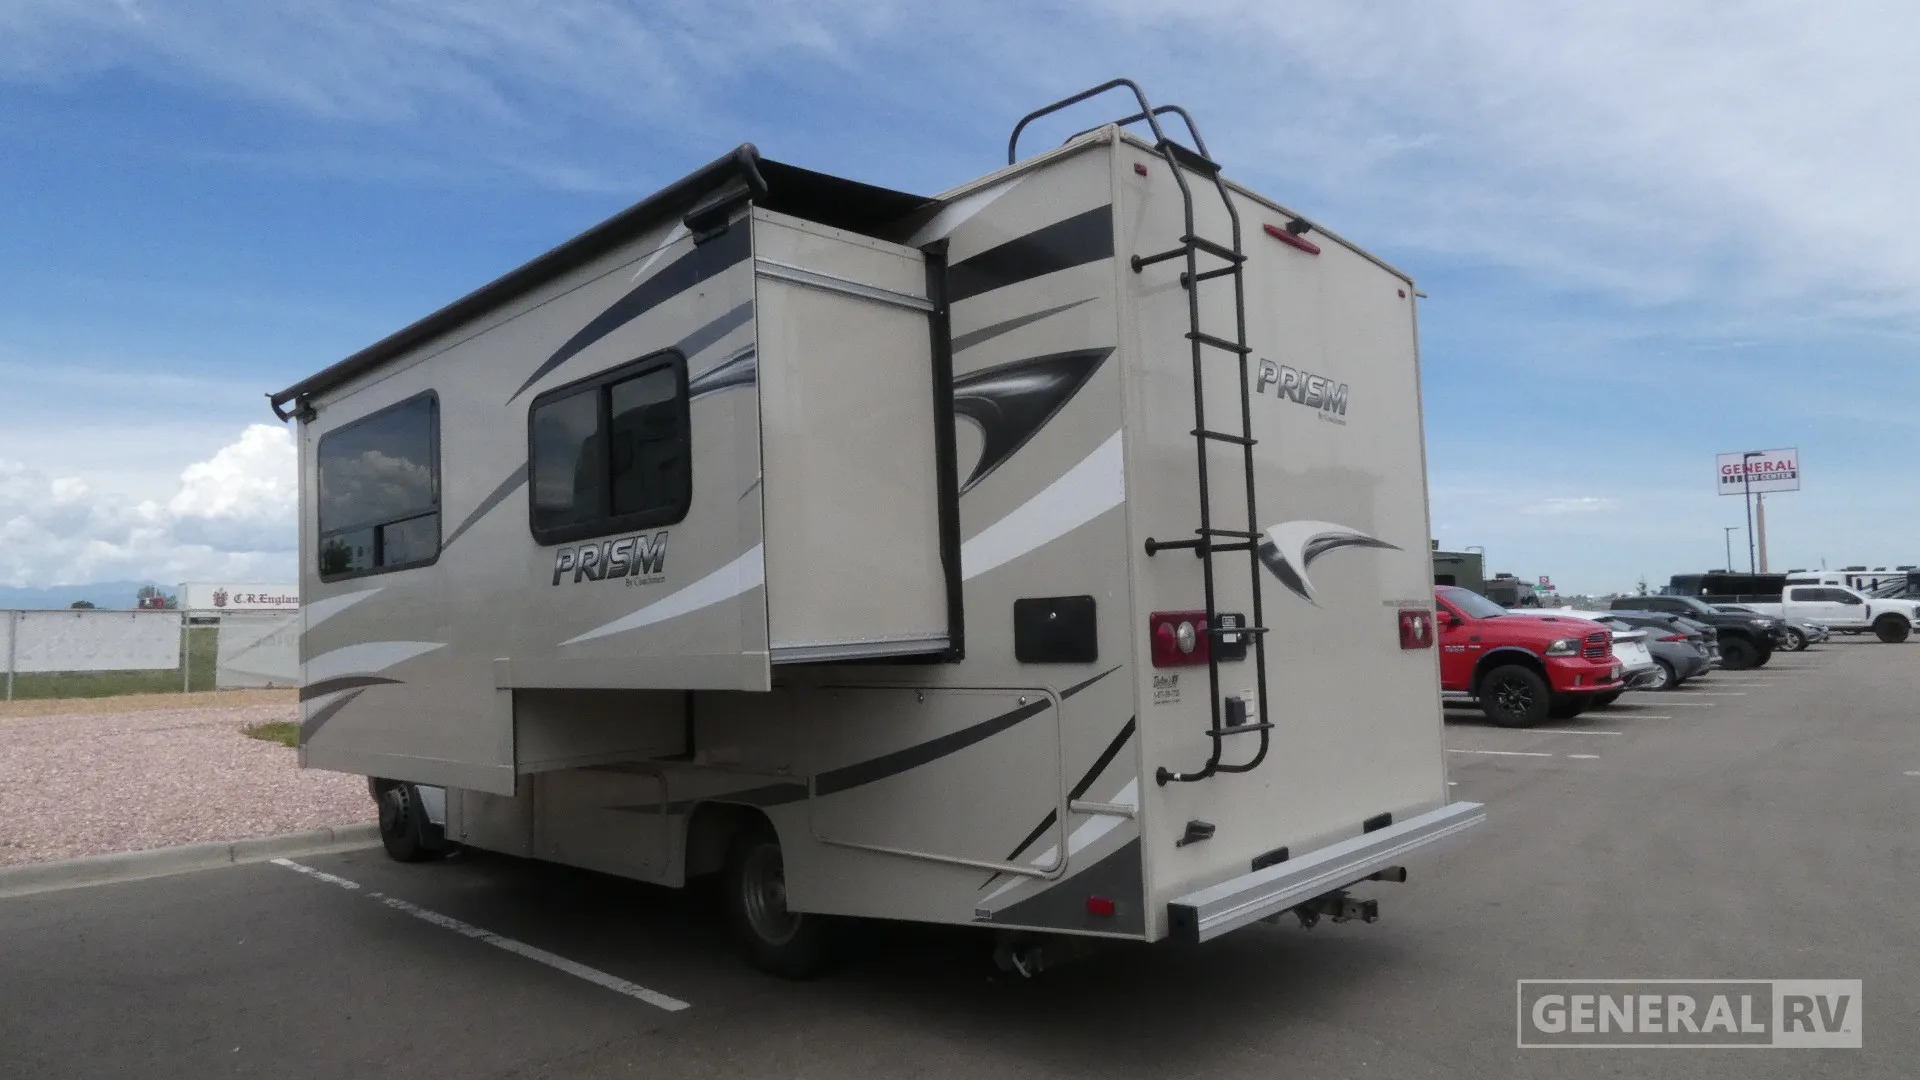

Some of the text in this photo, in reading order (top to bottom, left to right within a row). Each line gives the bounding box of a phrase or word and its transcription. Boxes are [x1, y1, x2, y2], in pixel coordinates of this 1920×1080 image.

[1256, 358, 1348, 415] PRISM
[1721, 460, 1796, 475] GENERAL
[552, 531, 668, 586] PRISM
